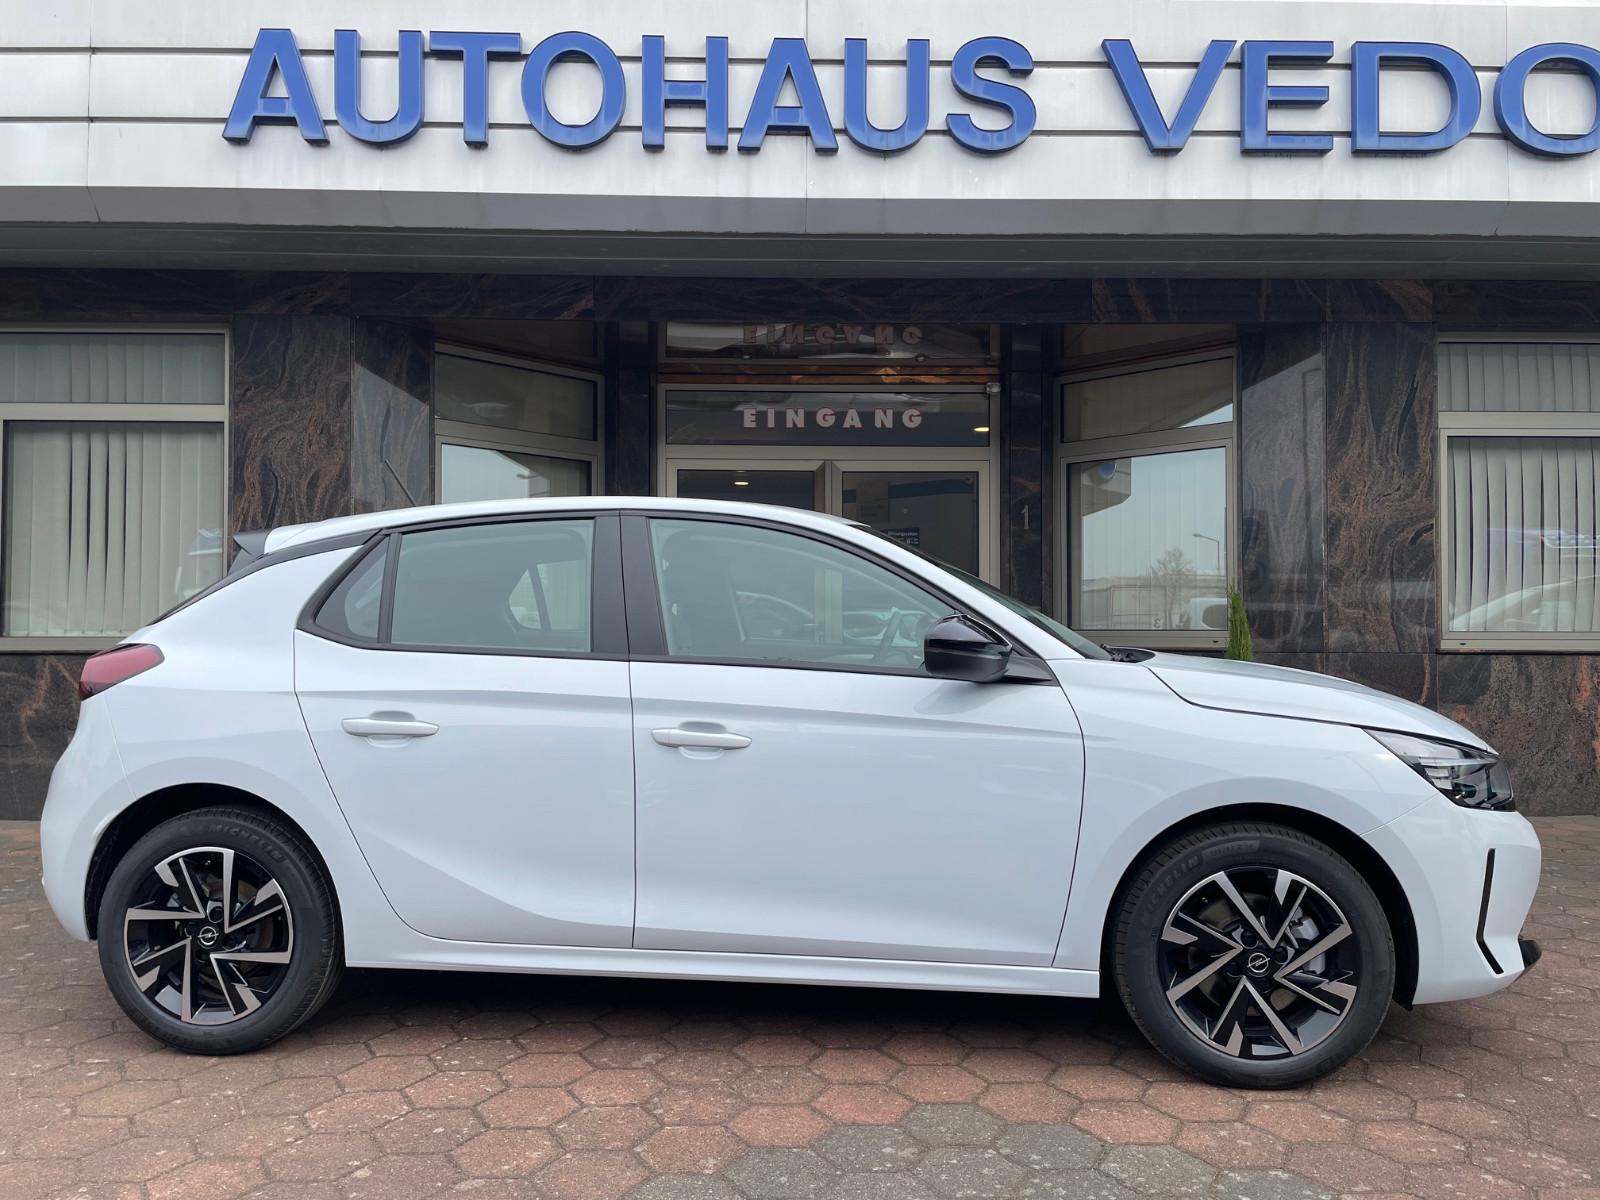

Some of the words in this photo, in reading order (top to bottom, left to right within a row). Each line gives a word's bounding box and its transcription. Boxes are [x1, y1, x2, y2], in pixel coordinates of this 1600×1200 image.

[222, 28, 1037, 154] AUTOHAUS
[1101, 39, 1600, 157] VEDO
[743, 407, 923, 429] EINGANG
[1020, 504, 1029, 530] 1
